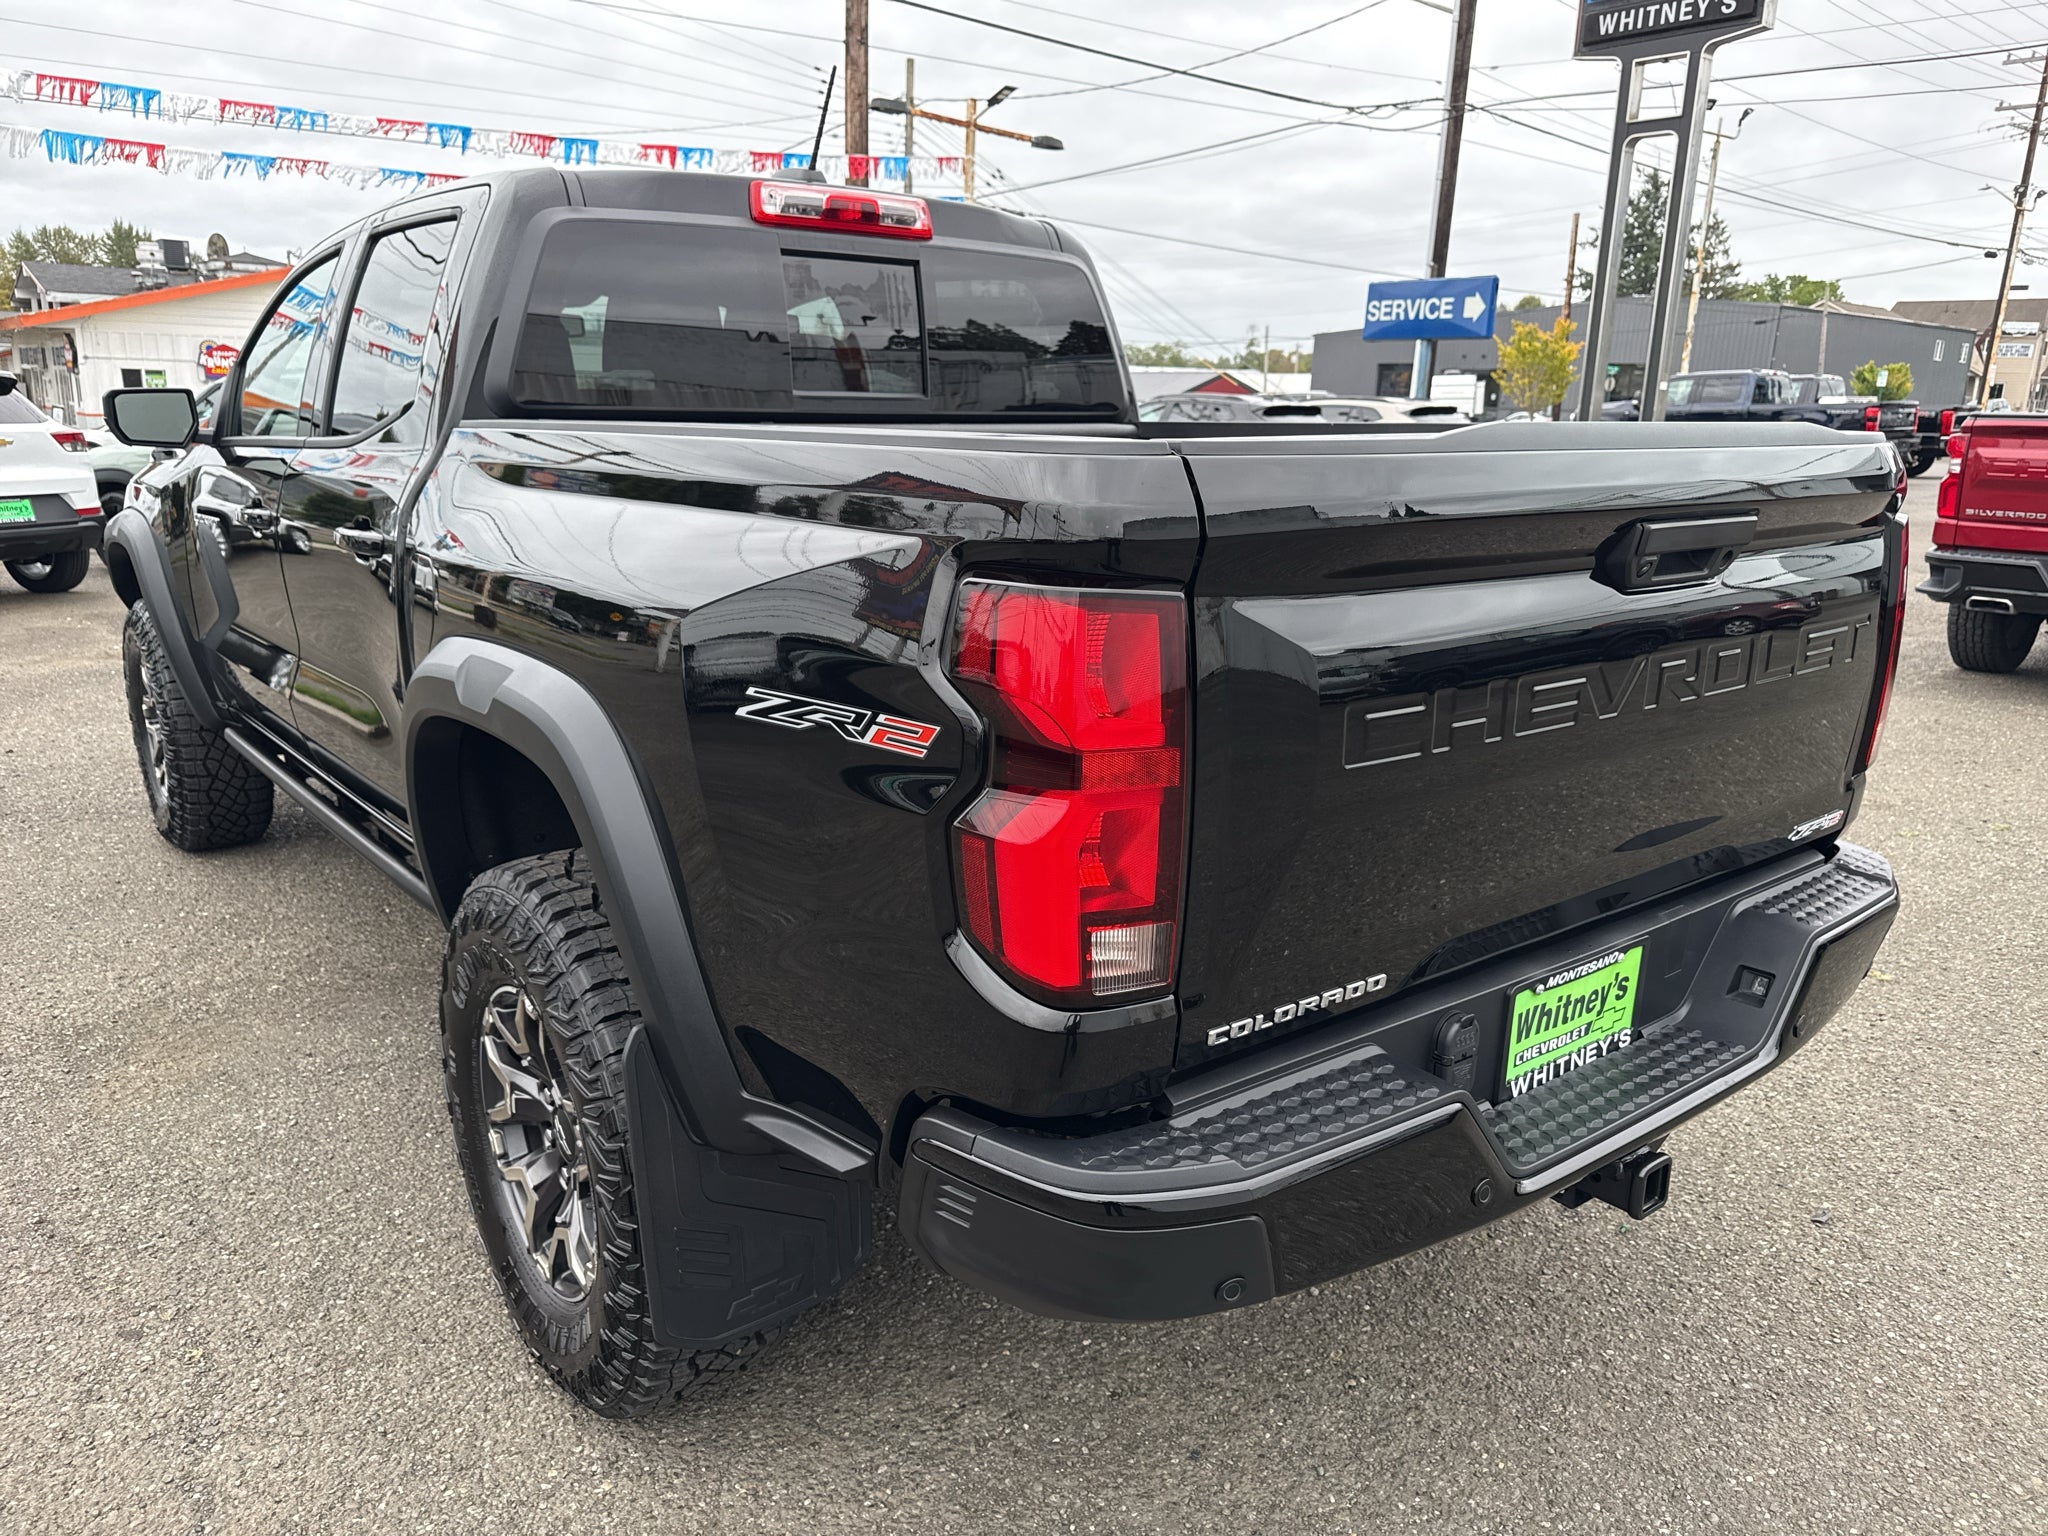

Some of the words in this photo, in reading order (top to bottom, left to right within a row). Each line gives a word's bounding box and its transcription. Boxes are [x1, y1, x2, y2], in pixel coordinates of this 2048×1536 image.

[1366, 297, 1455, 322] SERVICE
[1965, 508, 2046, 520] SILVERADO
[734, 686, 942, 759] ZR2
[1343, 615, 1871, 770] CHEVROLET
[1546, 951, 1619, 989] MONTESANO
[1207, 973, 1388, 1047] COLORADO
[1515, 971, 1630, 1045] Whitney's
[1510, 1028, 1633, 1098] WHITNEY'S
[1515, 1024, 1588, 1066] CHEVROLET
